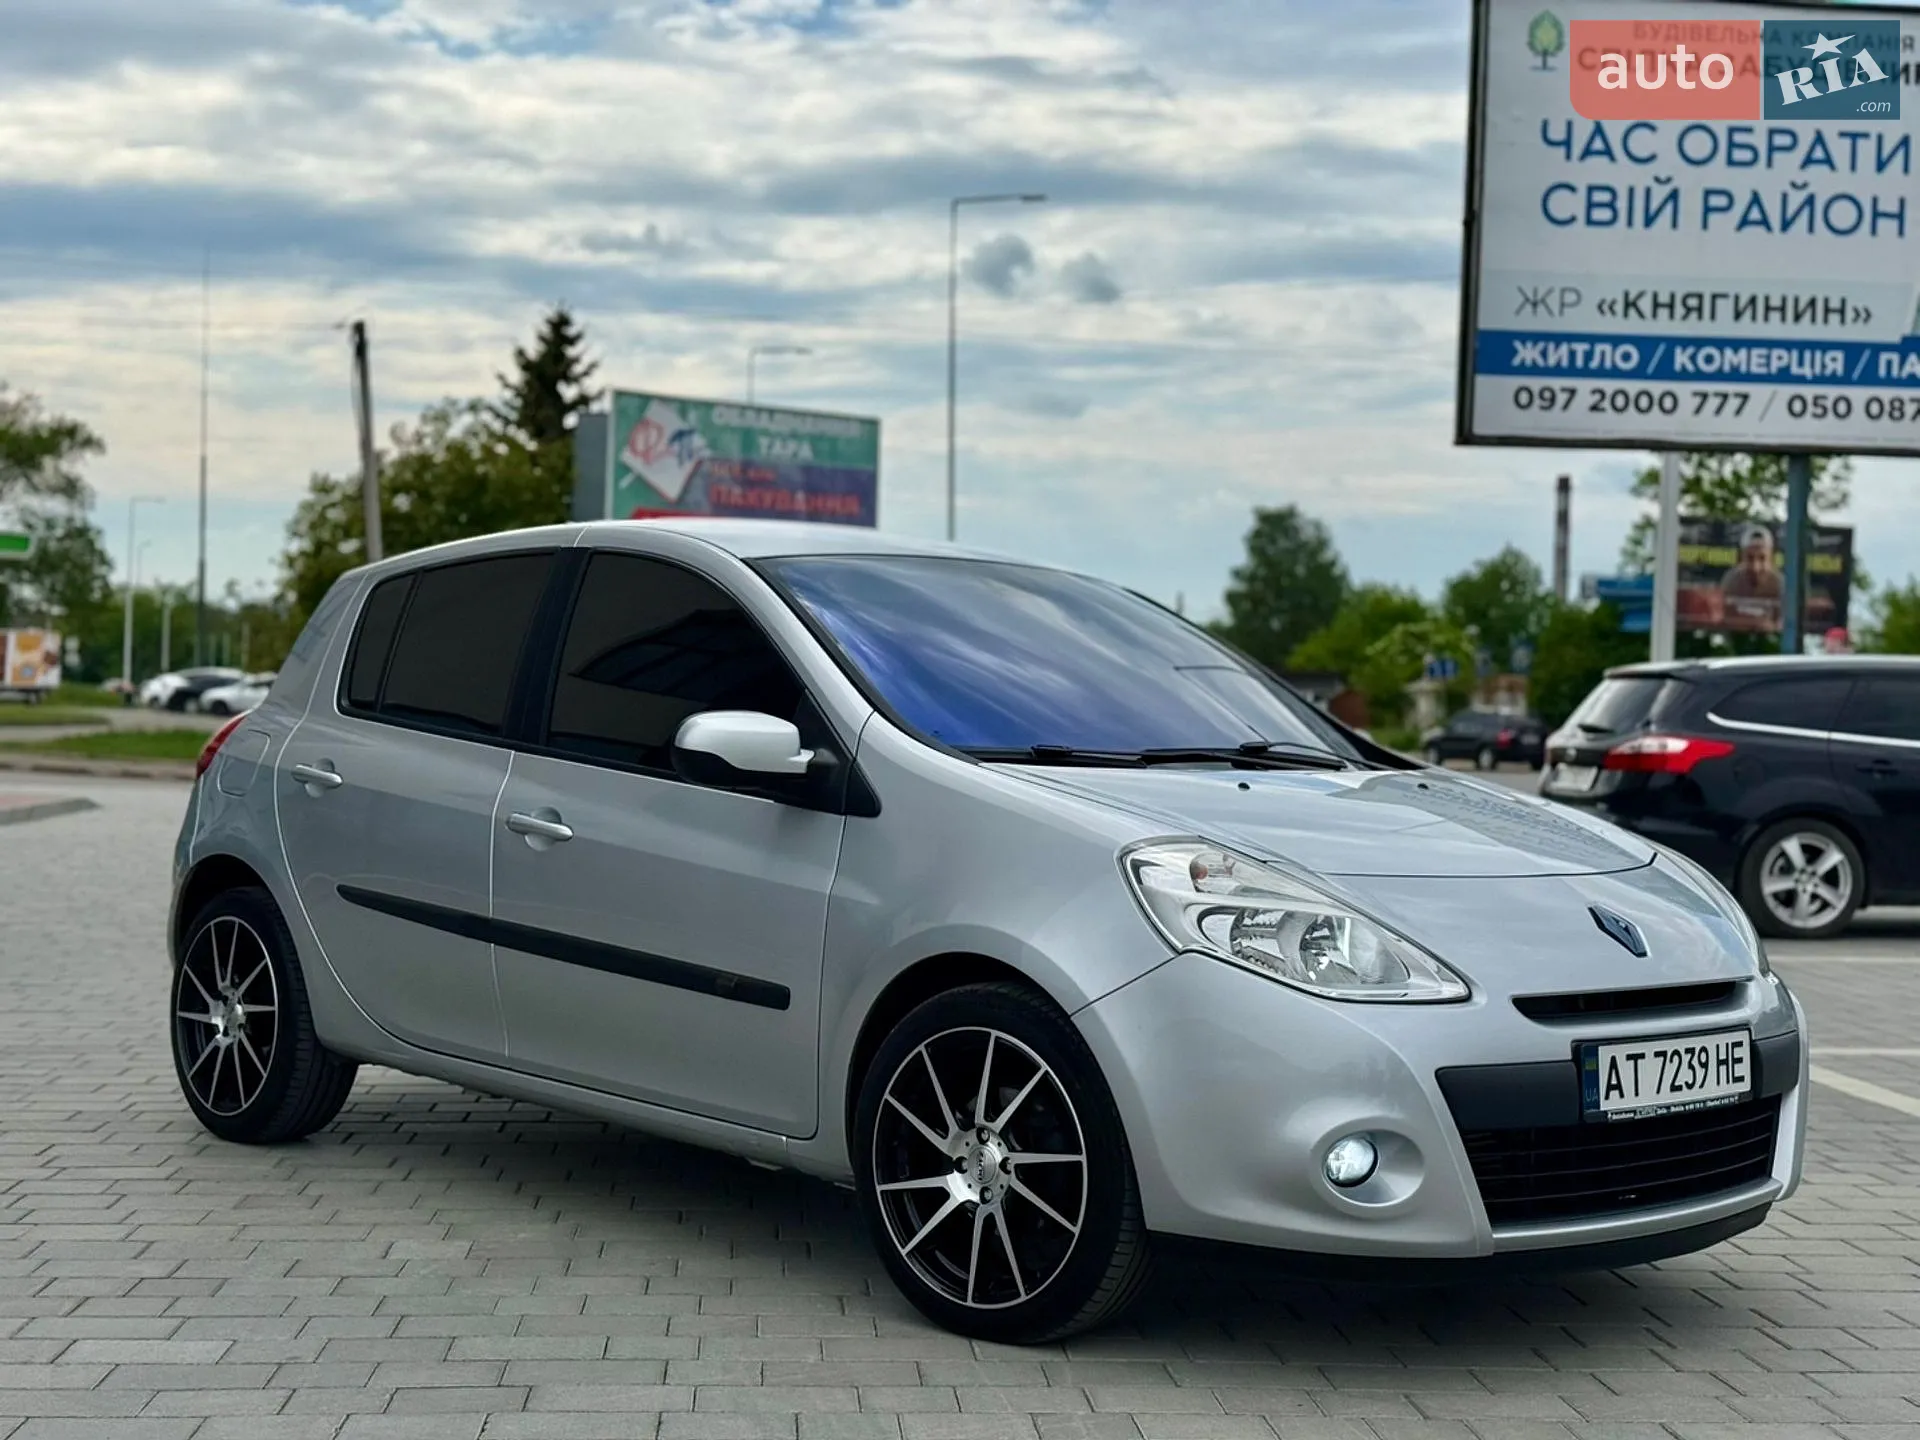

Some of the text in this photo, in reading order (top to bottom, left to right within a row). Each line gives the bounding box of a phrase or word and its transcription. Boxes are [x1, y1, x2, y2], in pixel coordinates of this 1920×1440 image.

[1541, 119, 1911, 174] ЧАС ОБРАТИ
[1541, 176, 1906, 237] СВІЙ РАЙОН
[1514, 286, 1873, 326] ЖР «КНЯГИНИН»
[1511, 340, 1640, 371] ЖИТЛО
[1674, 345, 1846, 379] КОМЕРЦІЯ
[1513, 386, 1578, 412] 097
[1588, 387, 1679, 415] 2000
[1691, 392, 1751, 418] 777
[1787, 394, 1853, 420] 050
[1865, 396, 1920, 422] 087
[758, 435, 814, 460] ТАРА
[1604, 1040, 1746, 1100] AT 7239 HE
